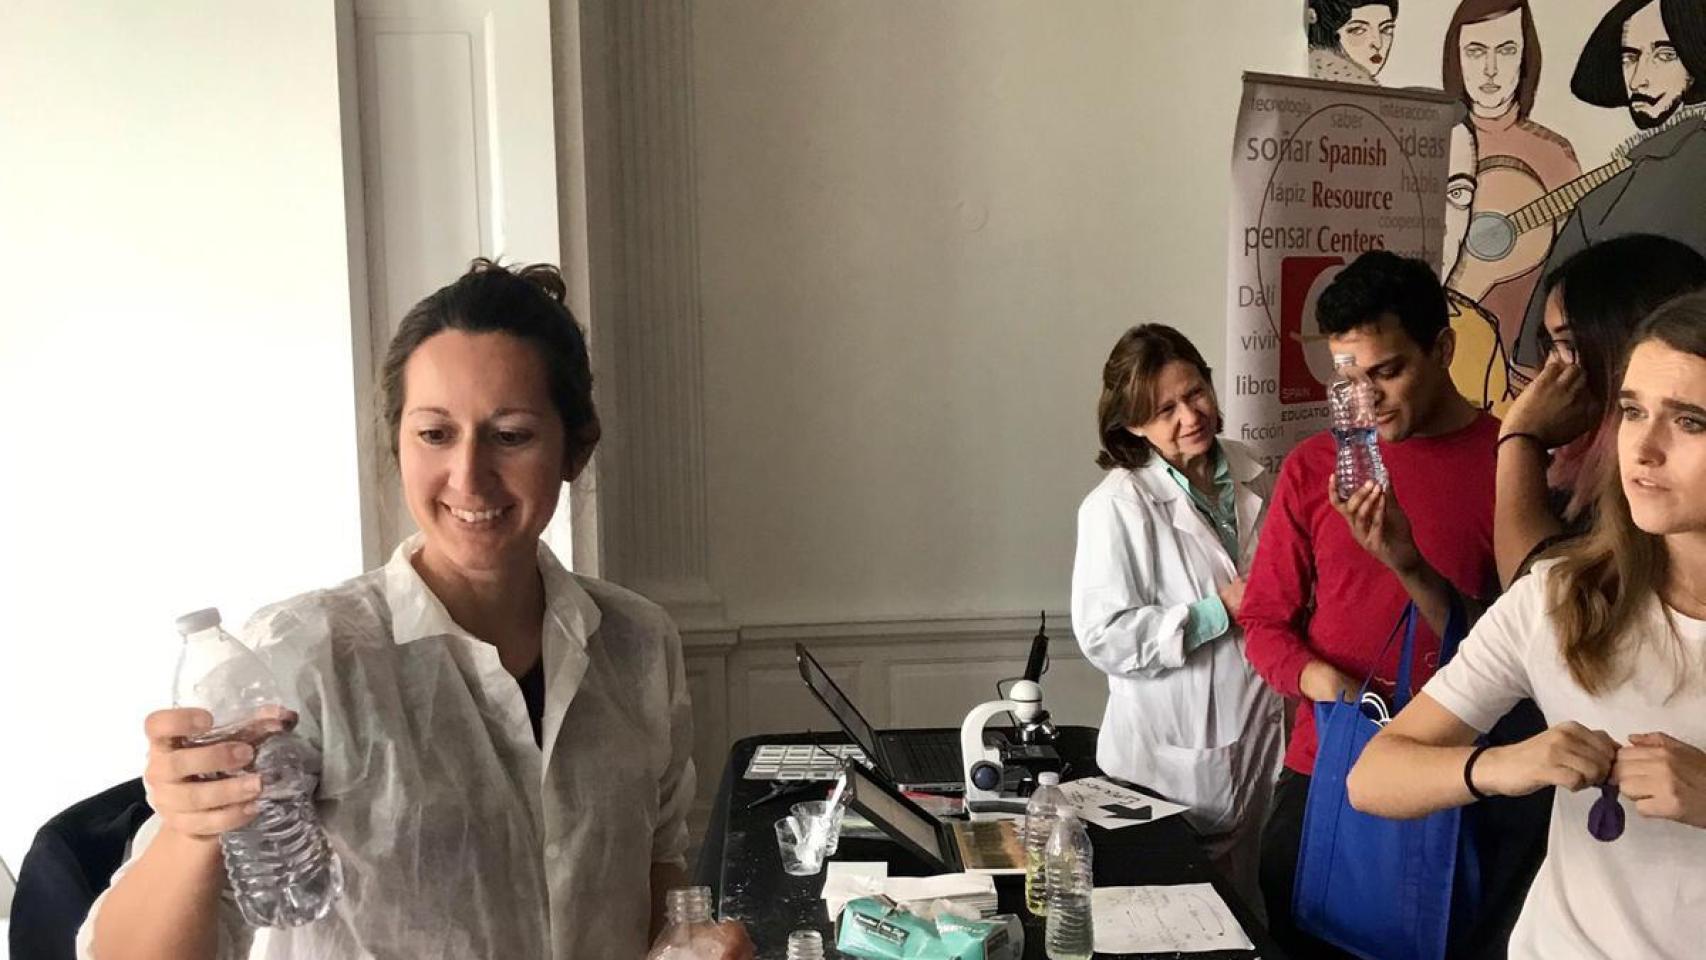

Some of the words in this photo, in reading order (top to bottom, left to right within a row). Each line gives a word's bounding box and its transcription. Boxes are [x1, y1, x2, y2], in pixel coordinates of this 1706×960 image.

[1331, 108, 1364, 128] saber
[1247, 131, 1312, 163] soñar
[1319, 135, 1387, 173] Spanish
[1400, 128, 1445, 158] ideas
[1271, 182, 1306, 206] lápiz
[1312, 181, 1393, 210] Resource
[1245, 226, 1312, 256] pensar
[1317, 225, 1385, 253] Centers
[1239, 285, 1276, 307] Dalí
[1236, 375, 1276, 396] libro
[1281, 408, 1330, 422] EDUCATIO
[1241, 423, 1284, 441] ficción
